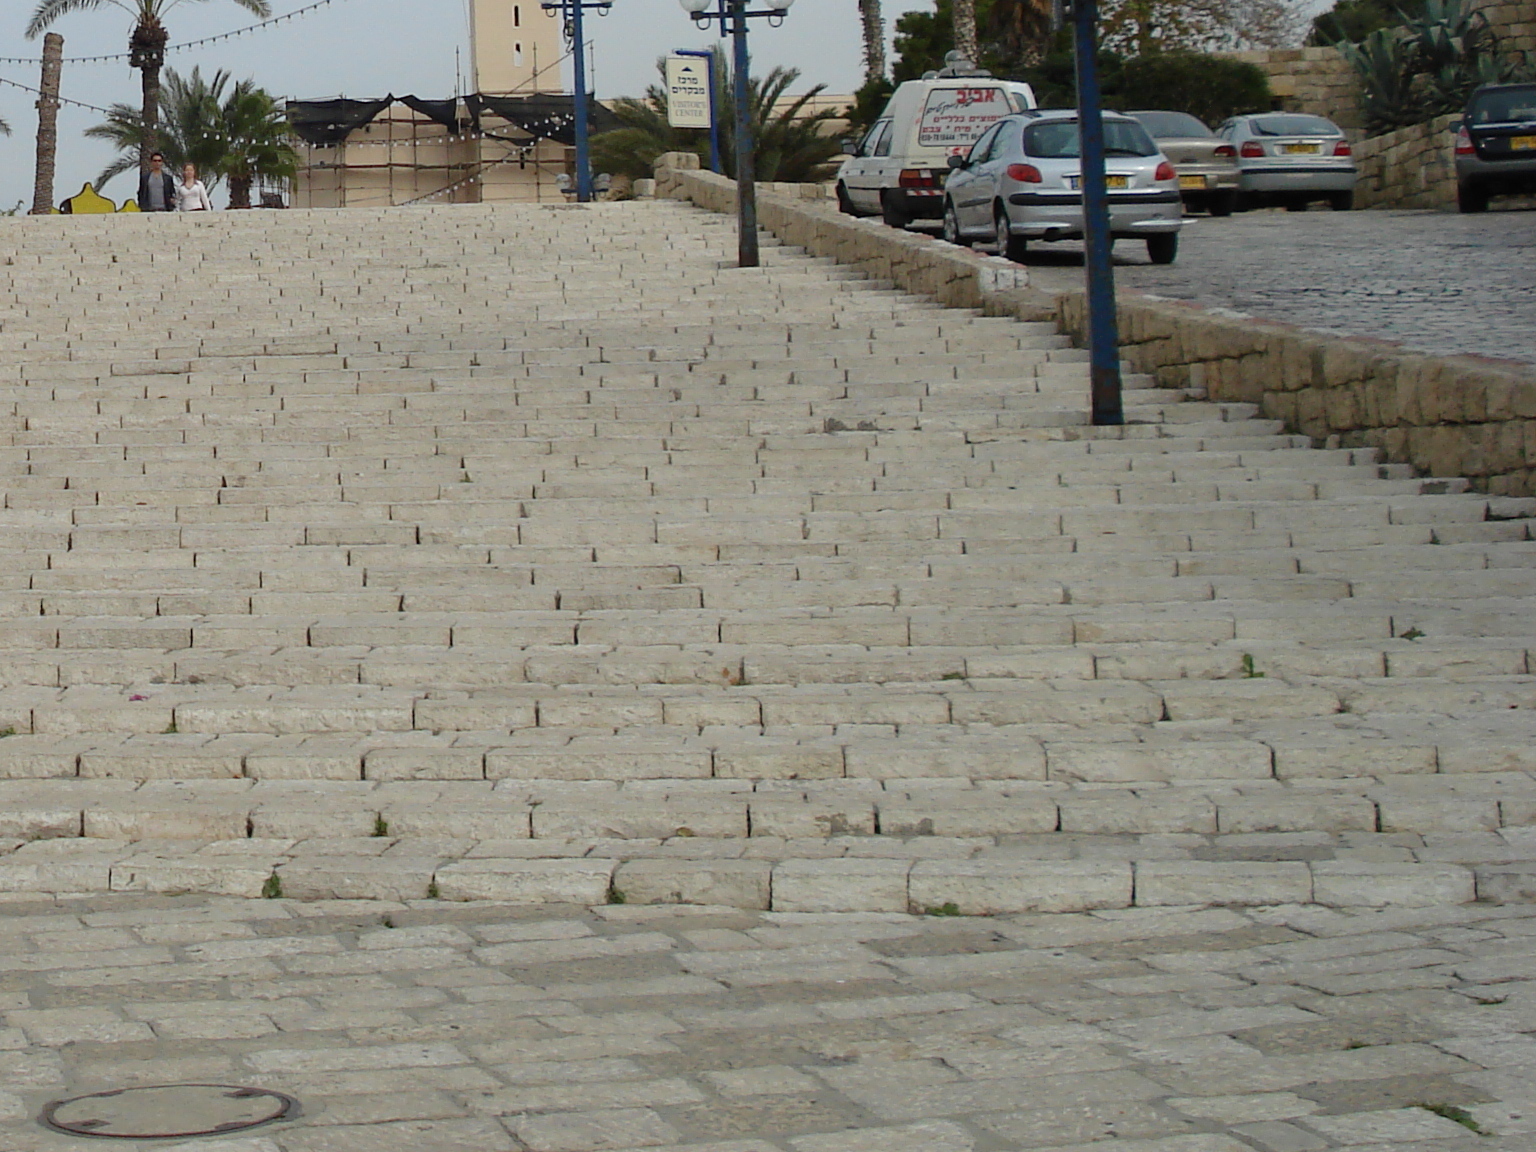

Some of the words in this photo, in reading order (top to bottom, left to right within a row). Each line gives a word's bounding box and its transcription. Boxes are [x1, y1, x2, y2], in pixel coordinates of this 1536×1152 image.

[678, 76, 698, 84] מרכז
[671, 86, 705, 95] מבקרים
[956, 89, 995, 104] אביב
[969, 114, 1004, 122] יפוצים
